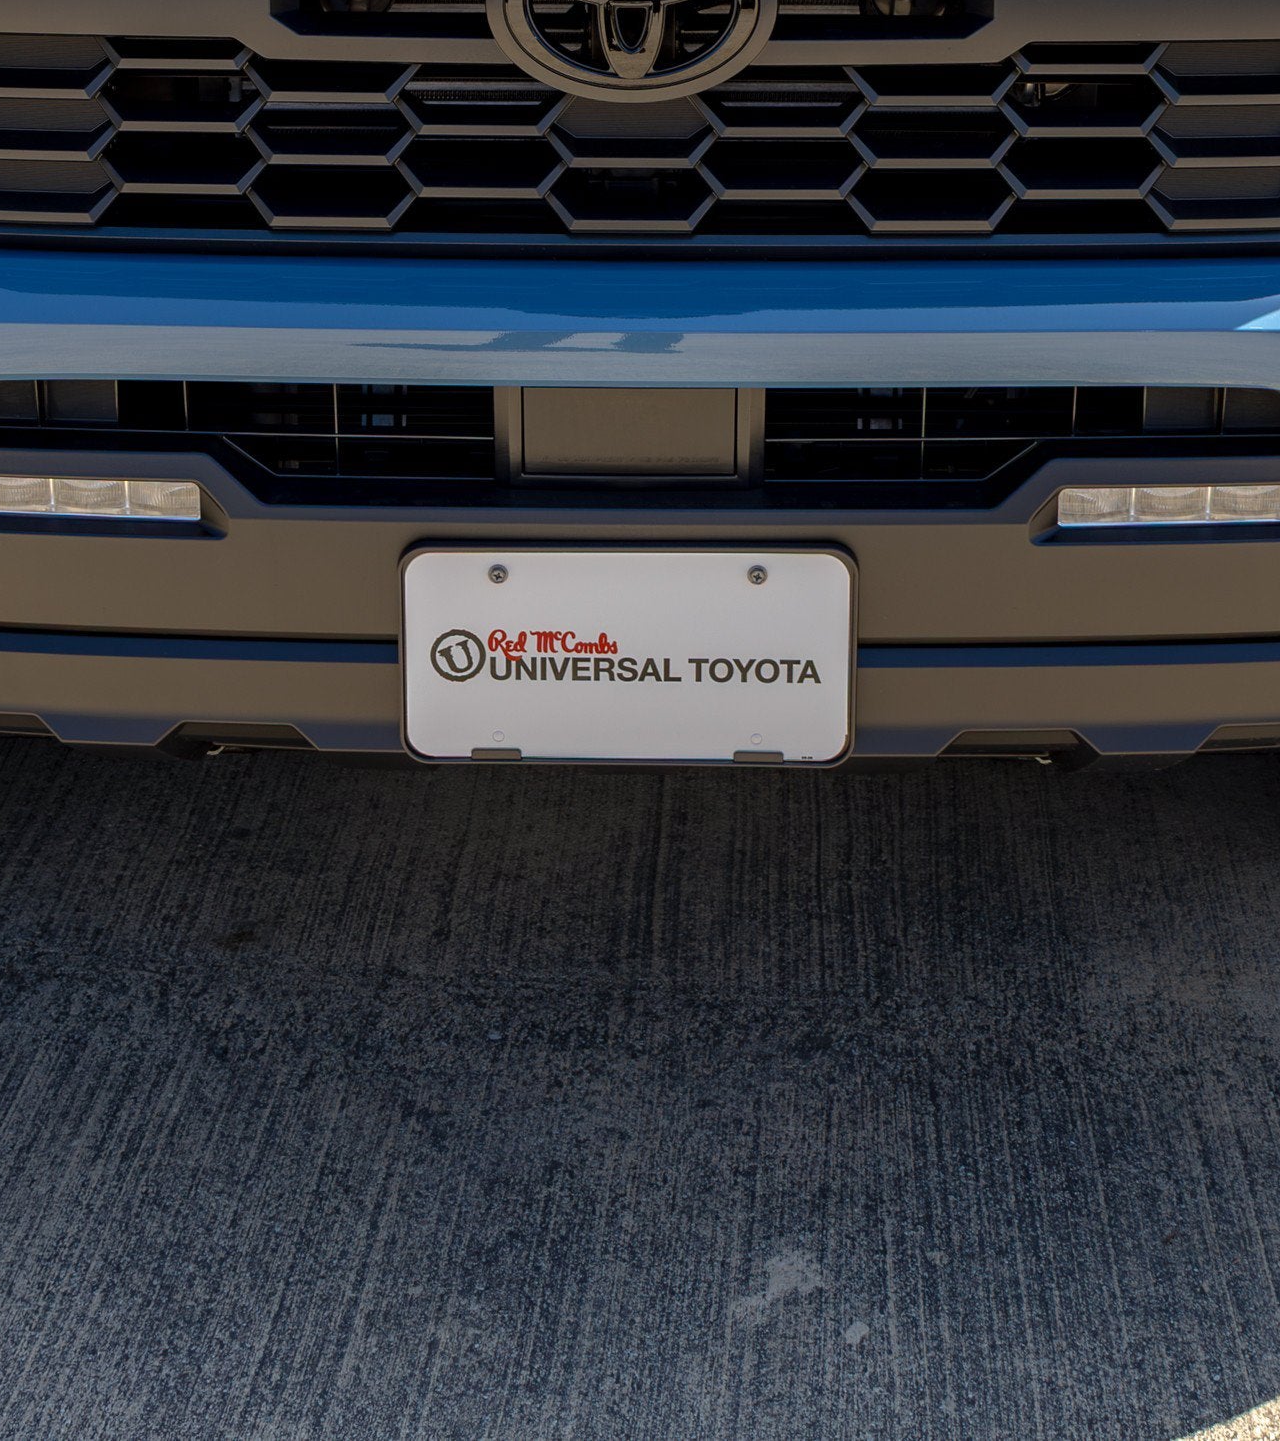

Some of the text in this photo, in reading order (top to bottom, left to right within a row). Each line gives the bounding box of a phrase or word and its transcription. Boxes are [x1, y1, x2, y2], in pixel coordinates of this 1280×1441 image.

[487, 629, 618, 662] Red McCombs
[489, 656, 822, 684] UNIVERSAL TOYOTA
